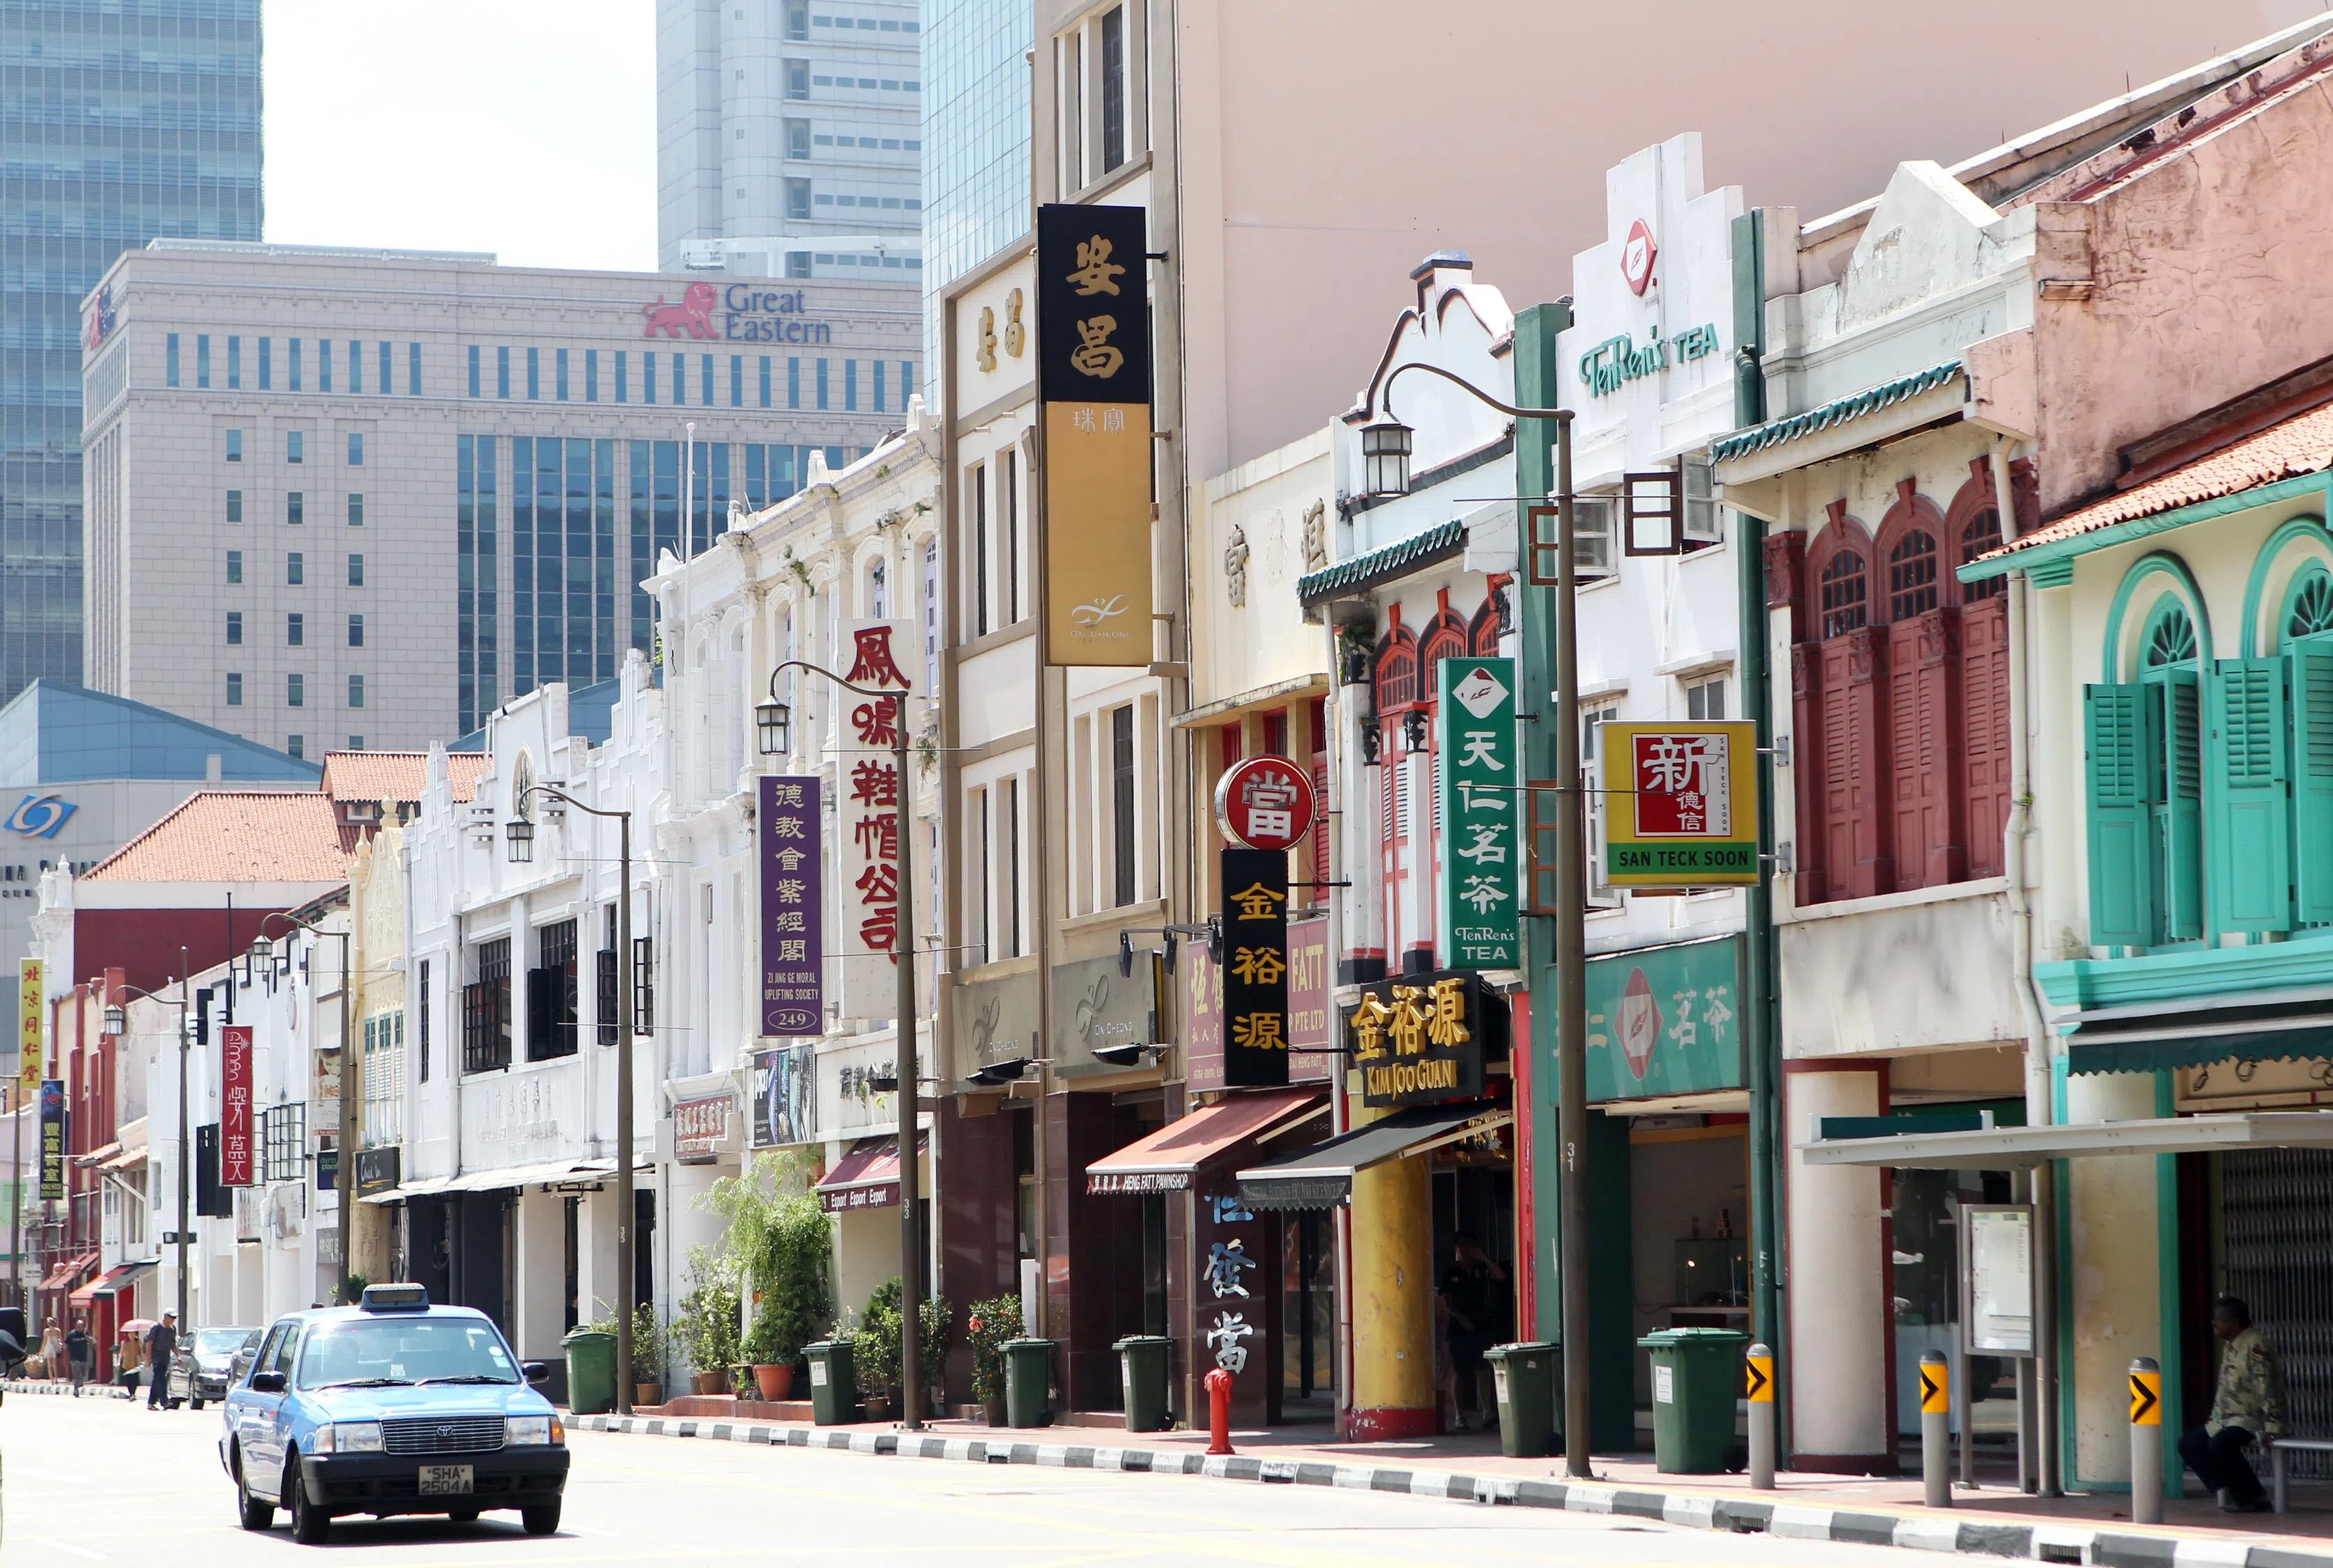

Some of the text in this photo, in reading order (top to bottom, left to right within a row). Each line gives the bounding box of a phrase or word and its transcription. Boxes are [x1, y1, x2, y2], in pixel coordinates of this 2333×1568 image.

[726, 283, 806, 314] Great
[727, 312, 831, 343] Eastern
[1672, 322, 1719, 364] TEA
[1242, 770, 1298, 840] 當
[1458, 732, 1509, 915] 天仁茗茶
[776, 784, 806, 963] 德教會紫經閣
[1619, 850, 1748, 867] SAN TECK SOON
[1230, 882, 1286, 1050] 金裕源
[1292, 944, 1324, 993] FATT
[1462, 946, 1509, 960] TEA
[767, 973, 816, 984] ZI JING GE MORAL
[764, 989, 819, 1001] UPLIFTING SOCIETY
[778, 1013, 806, 1026] 249
[1295, 1012, 1309, 1033] PTE
[1311, 1008, 1324, 1030] LTD
[1351, 978, 1470, 1061] 金裕源
[1367, 1059, 1457, 1101] KIM JOO GUAN
[1123, 1175, 1140, 1190] HENG
[1140, 1175, 1156, 1189] FATT
[1156, 1173, 1188, 1189] PAWNSHOP
[831, 1193, 847, 1210] Export
[850, 1191, 866, 1207] Export
[869, 1188, 887, 1206] Export
[432, 1467, 460, 1480] SHA
